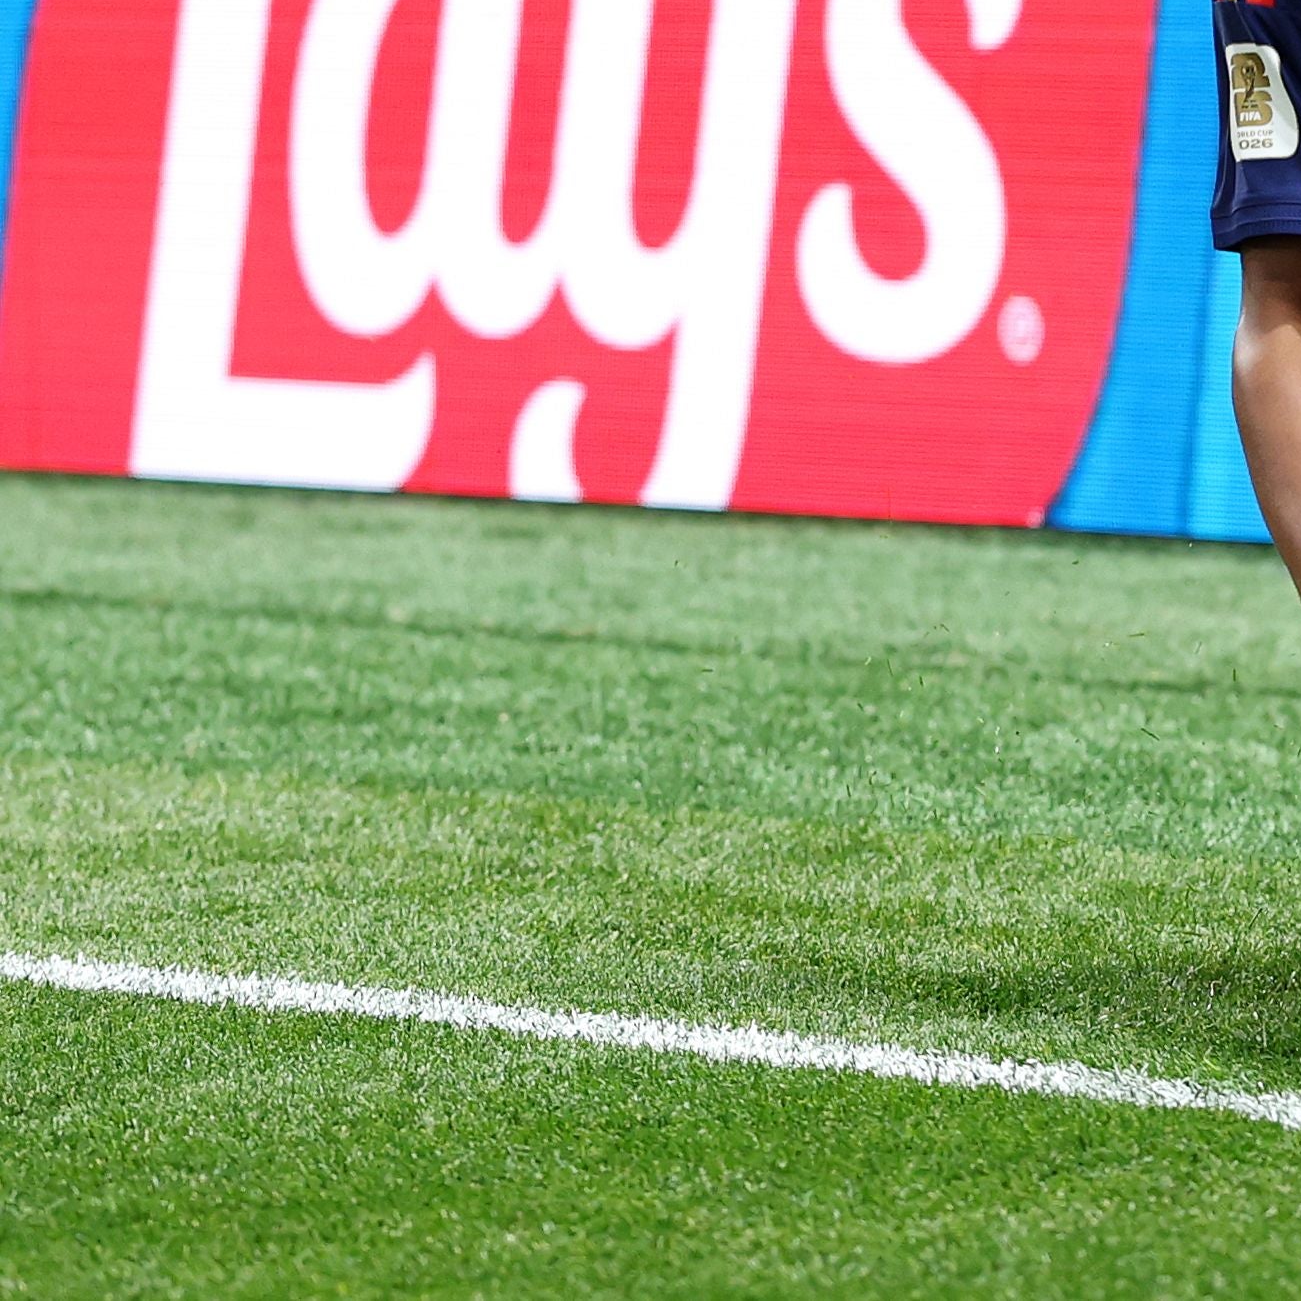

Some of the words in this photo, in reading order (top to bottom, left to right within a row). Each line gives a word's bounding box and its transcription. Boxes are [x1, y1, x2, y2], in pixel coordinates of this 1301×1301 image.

[1240, 111, 1261, 121] FIFA
[1257, 129, 1274, 137] CUP
[1239, 139, 1273, 149] 026
